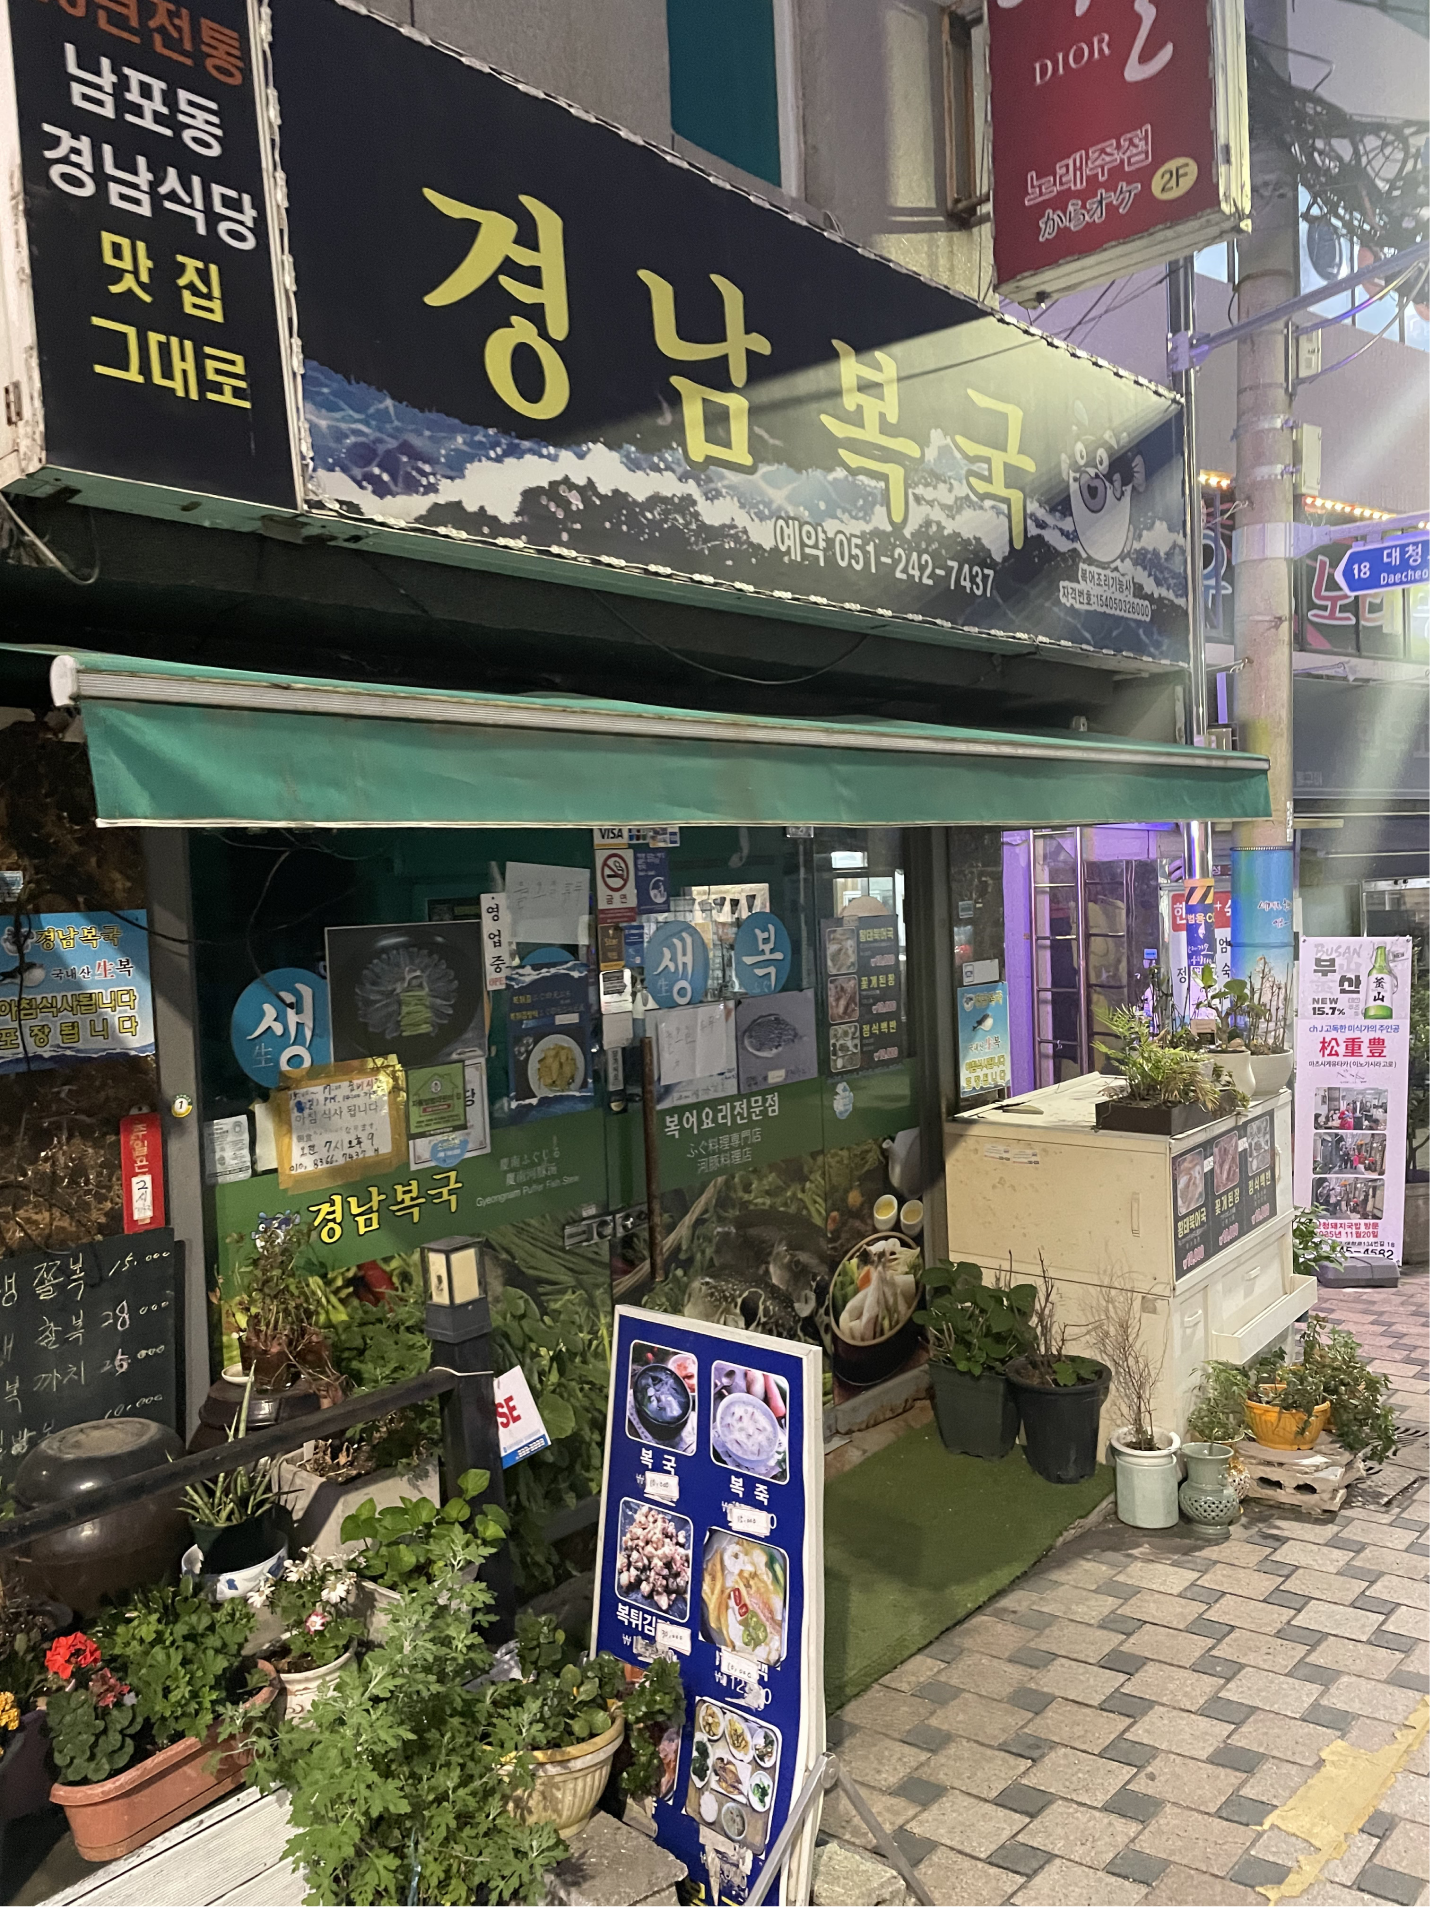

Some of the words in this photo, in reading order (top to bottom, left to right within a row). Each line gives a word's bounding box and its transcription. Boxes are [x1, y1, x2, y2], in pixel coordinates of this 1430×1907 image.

[1033, 32, 1111, 86] DIOR
[64, 42, 223, 158] 남포동
[1025, 123, 1151, 206] 노래주점
[1161, 162, 1191, 195] 2F
[43, 122, 258, 250] 경남식당
[1039, 182, 1141, 242] からオケ
[91, 316, 252, 409] 그대로
[774, 516, 827, 568] 예약
[834, 529, 995, 598] 051-242-7437
[1353, 562, 1372, 581] 18
[1383, 544, 1430, 566] 대청
[1080, 566, 1132, 596] 복어조리기능사
[600, 828, 624, 840] VISA
[36, 925, 123, 951] 경남복국
[486, 903, 507, 974] 영업중
[1314, 943, 1363, 958] BUSAN
[51, 966, 91, 980] 국내산
[653, 931, 693, 1005] 생
[741, 923, 784, 990] 복
[1312, 1007, 1346, 1016] 15.7%
[247, 982, 314, 1078] 생
[1324, 1024, 1346, 1034] 고독한
[1348, 1024, 1377, 1034] 미식가의
[1378, 1024, 1400, 1034] 주인공
[253, 1042, 274, 1068] 生
[295, 1110, 317, 1125] 아침
[322, 1106, 343, 1121] 식사
[347, 1101, 378, 1118] 됩니다
[664, 1092, 779, 1138] 복어요리전문점
[300, 1144, 319, 1157] 오전
[308, 1171, 463, 1244] 경남복국
[476, 1188, 521, 1207] Gyeongnam
[1364, 1221, 1379, 1231] 방문
[616, 1603, 656, 1636] 복튀김
